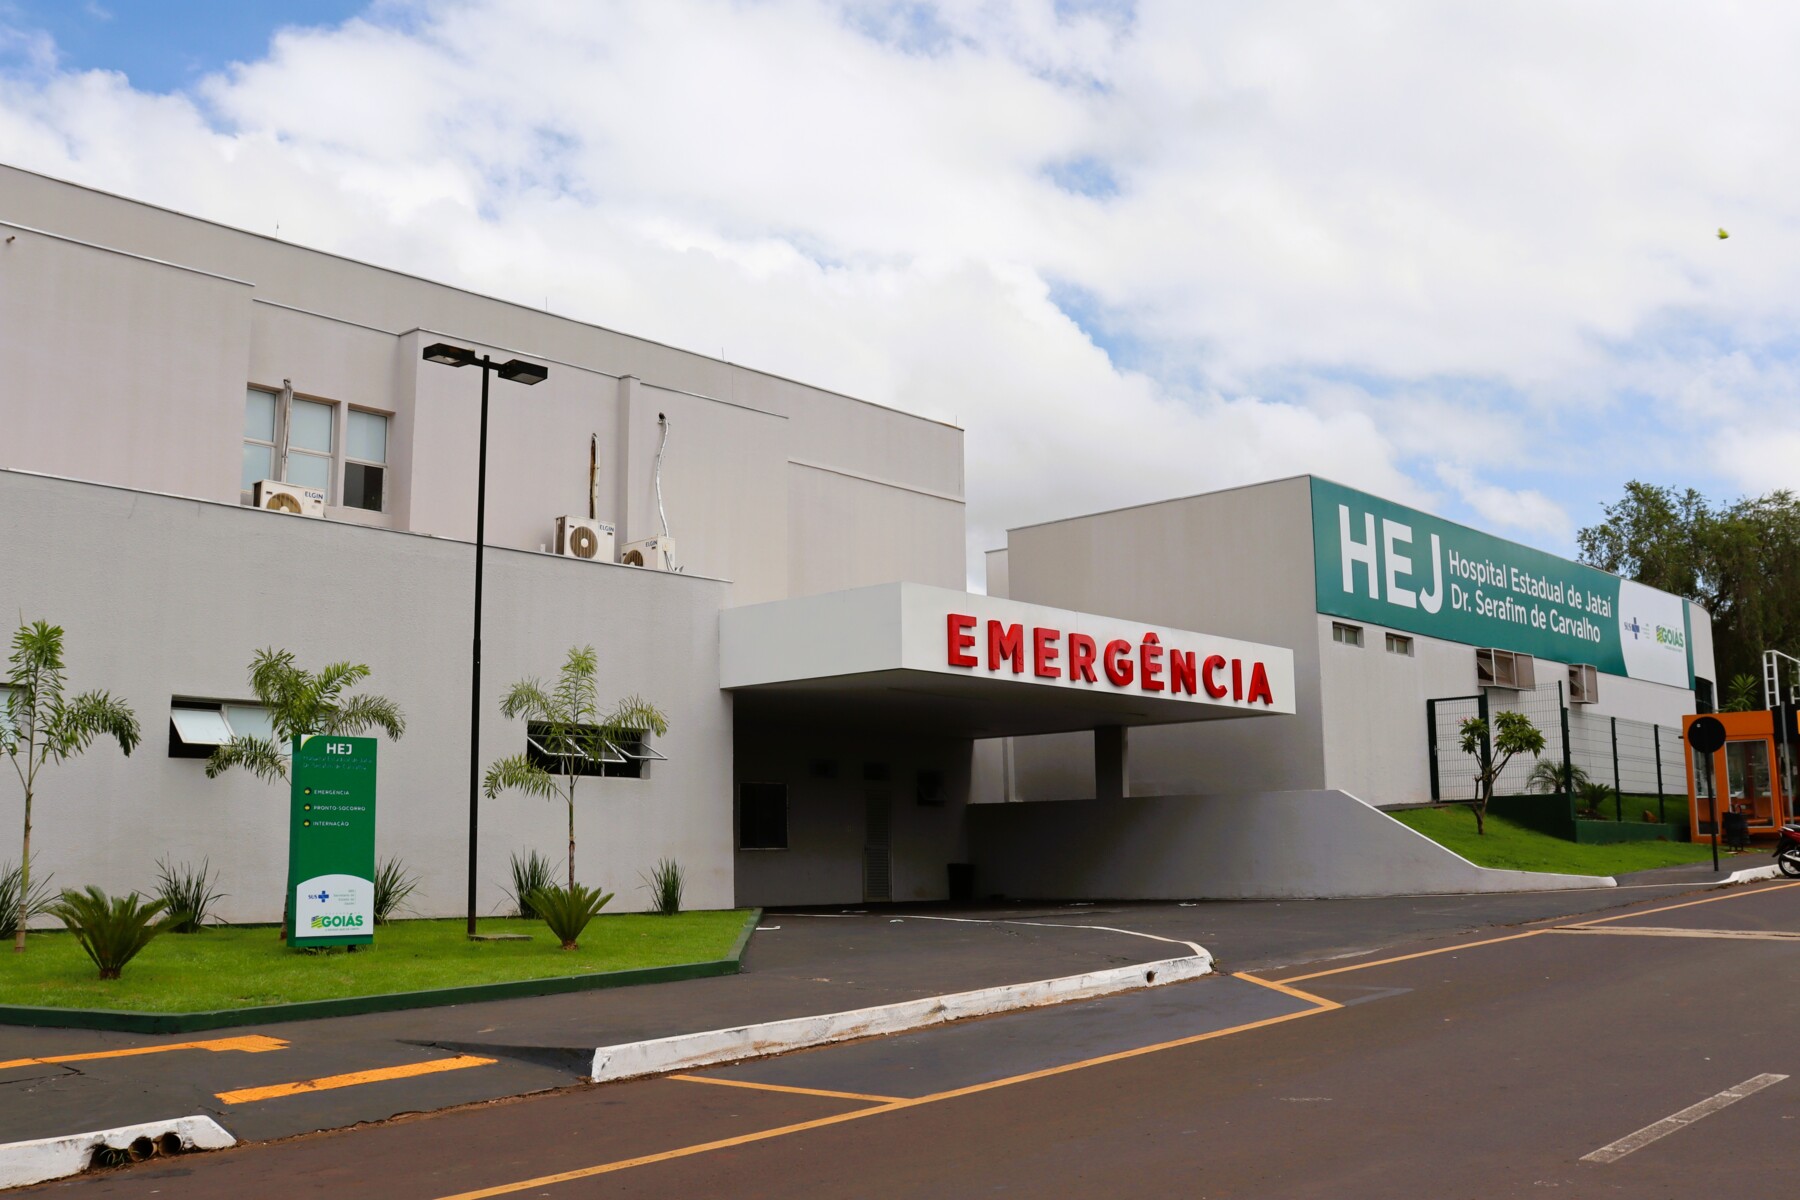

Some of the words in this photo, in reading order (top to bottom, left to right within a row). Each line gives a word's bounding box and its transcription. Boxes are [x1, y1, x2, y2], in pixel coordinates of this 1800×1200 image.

[304, 491, 323, 500] ELGIN
[1338, 503, 1444, 614] HEJ
[1448, 549, 1508, 587] Hospital
[1510, 566, 1565, 605] Estadual
[1567, 584, 1583, 609] de
[1585, 590, 1612, 618] Jataí
[1451, 583, 1472, 613] Dr.
[1475, 589, 1528, 625] Serafim
[1530, 603, 1547, 630] de
[1550, 608, 1601, 643] Carvalho
[1662, 628, 1684, 648] GOIÁS
[946, 612, 1274, 705] EMERGÊNCIA
[327, 743, 352, 755] HEJ
[322, 913, 363, 927] GOIÁS
